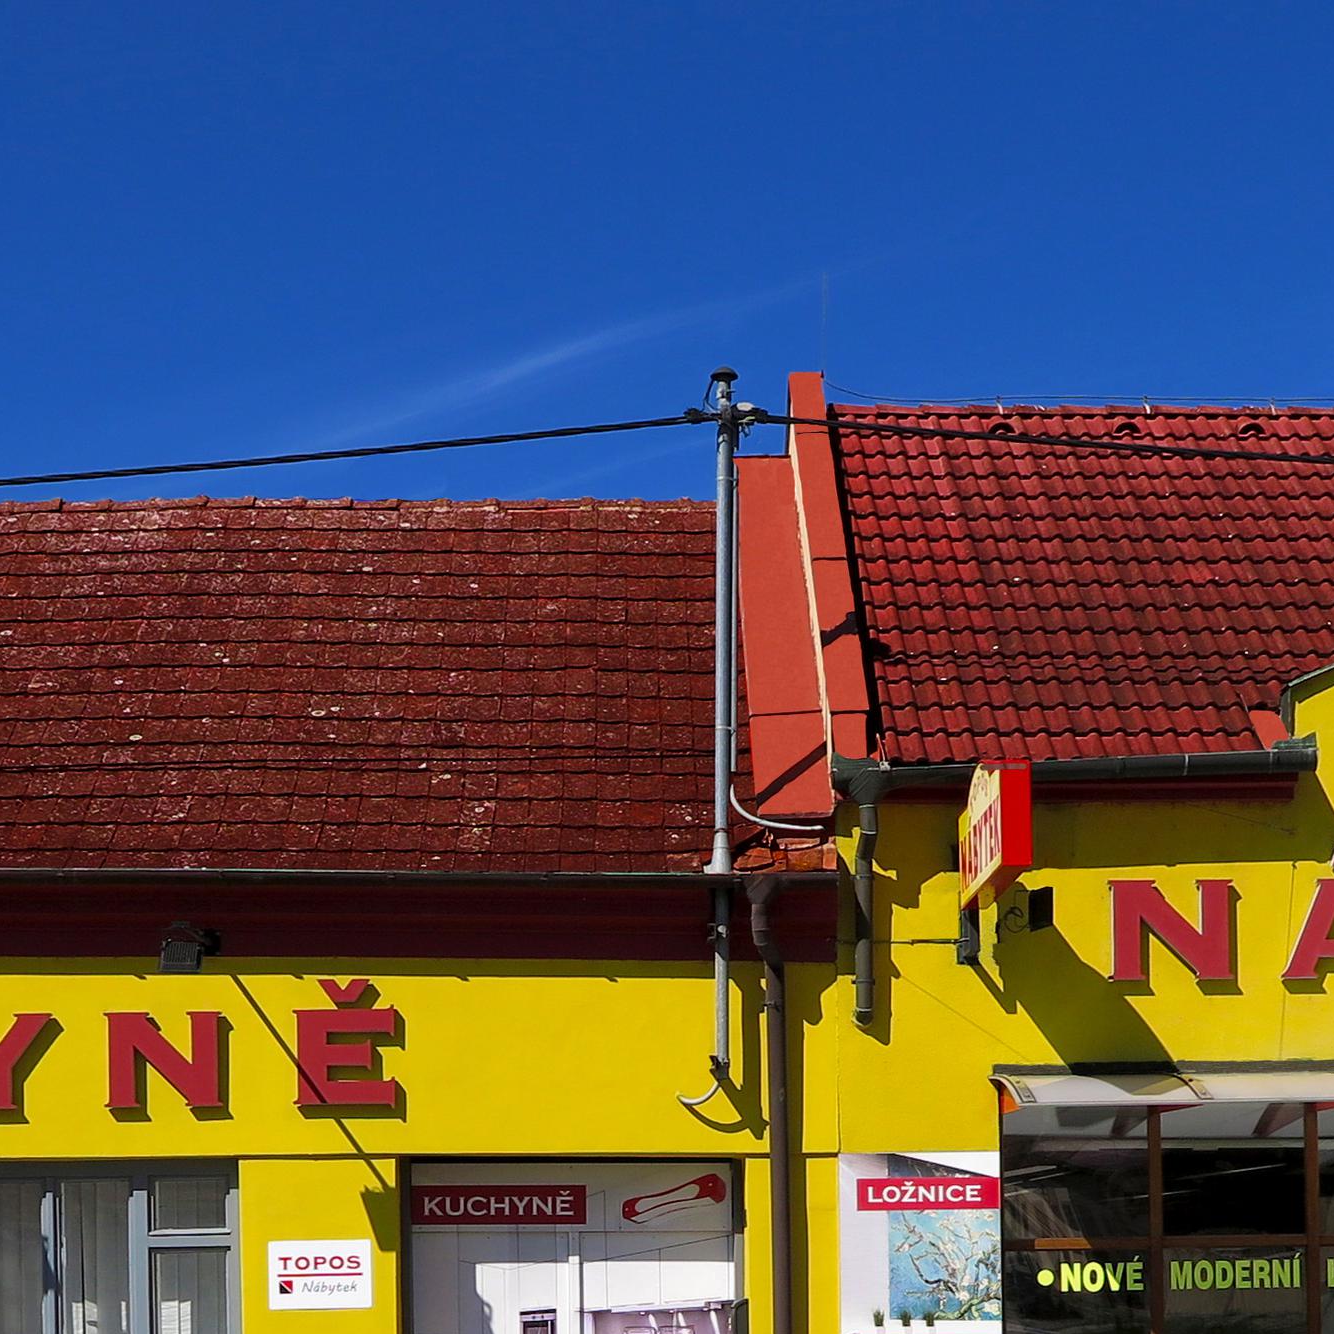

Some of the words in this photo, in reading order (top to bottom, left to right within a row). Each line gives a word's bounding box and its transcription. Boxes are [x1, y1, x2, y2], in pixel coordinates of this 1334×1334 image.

[423, 1190, 575, 1216] KUCHYNĚ
[867, 1181, 982, 1203] LOŽNICE
[278, 1255, 361, 1271] TOPOS
[1060, 1256, 1145, 1293] NOVÉ
[1170, 1253, 1302, 1290] MODERNÍ
[302, 1280, 359, 1296] Nábytek
